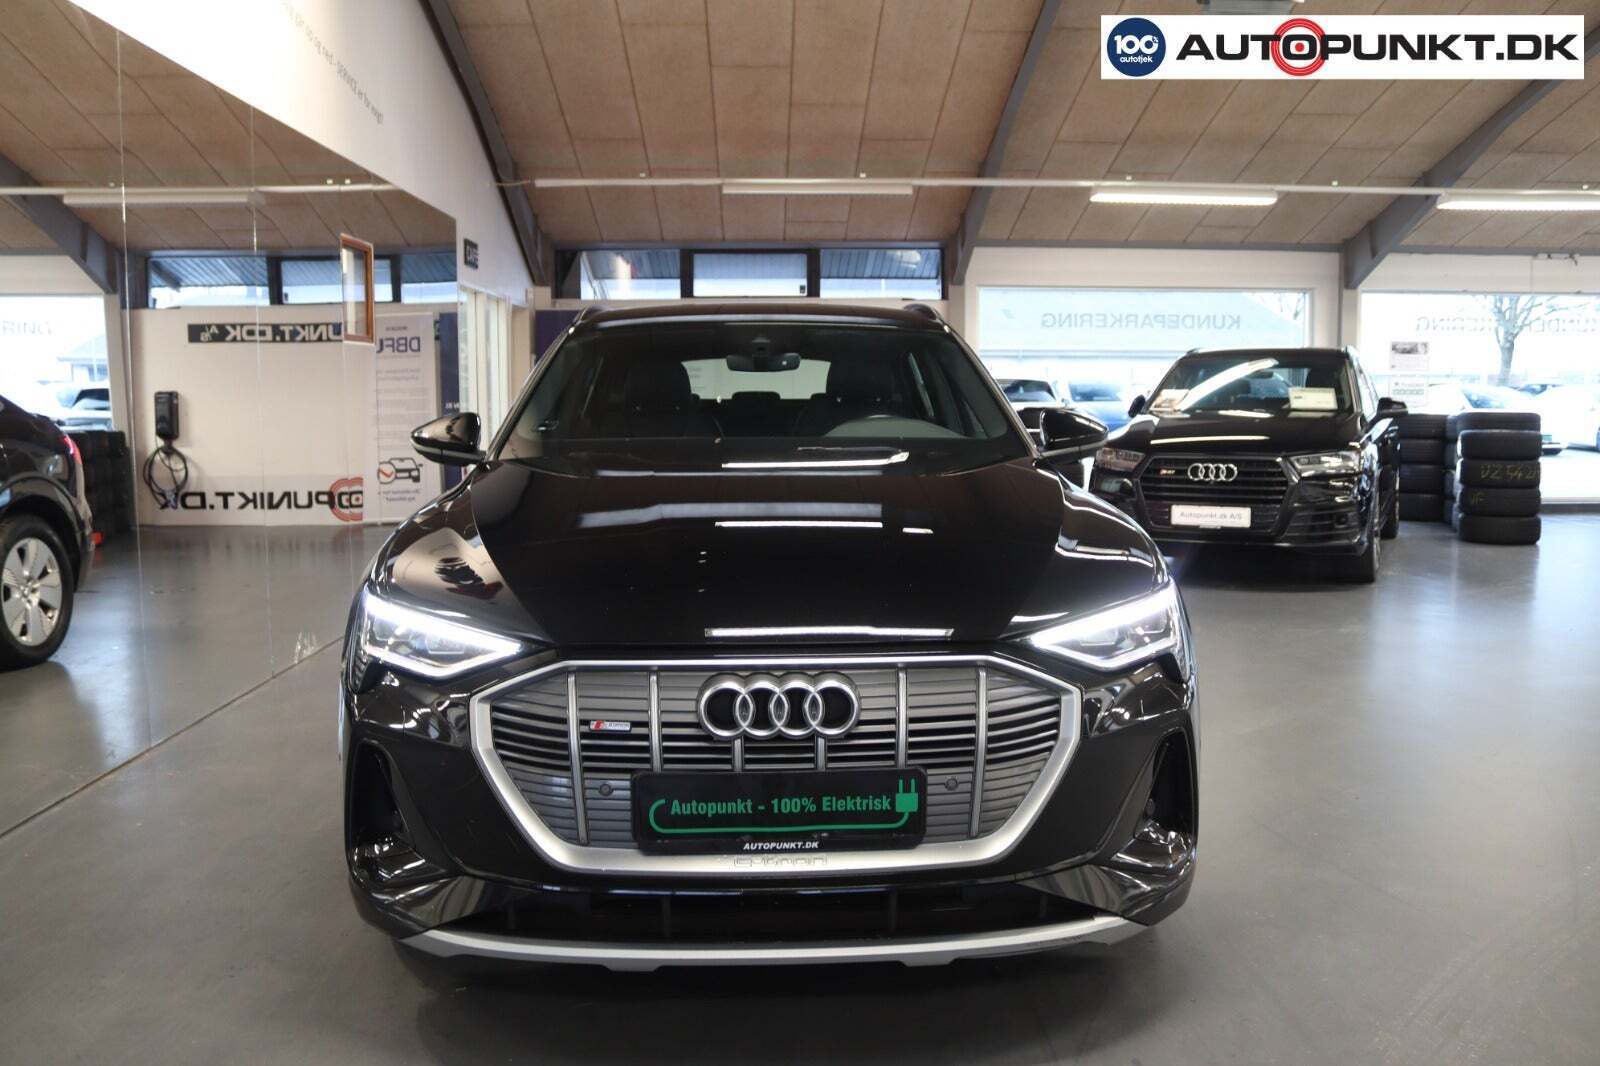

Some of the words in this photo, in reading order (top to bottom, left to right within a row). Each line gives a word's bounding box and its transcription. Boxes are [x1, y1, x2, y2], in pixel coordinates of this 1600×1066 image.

[670, 798, 753, 818] Autopunkt
[771, 797, 817, 814] 100%
[822, 795, 891, 812] Elektrisk
[743, 840, 820, 851] AUTOPUNKT.DK
